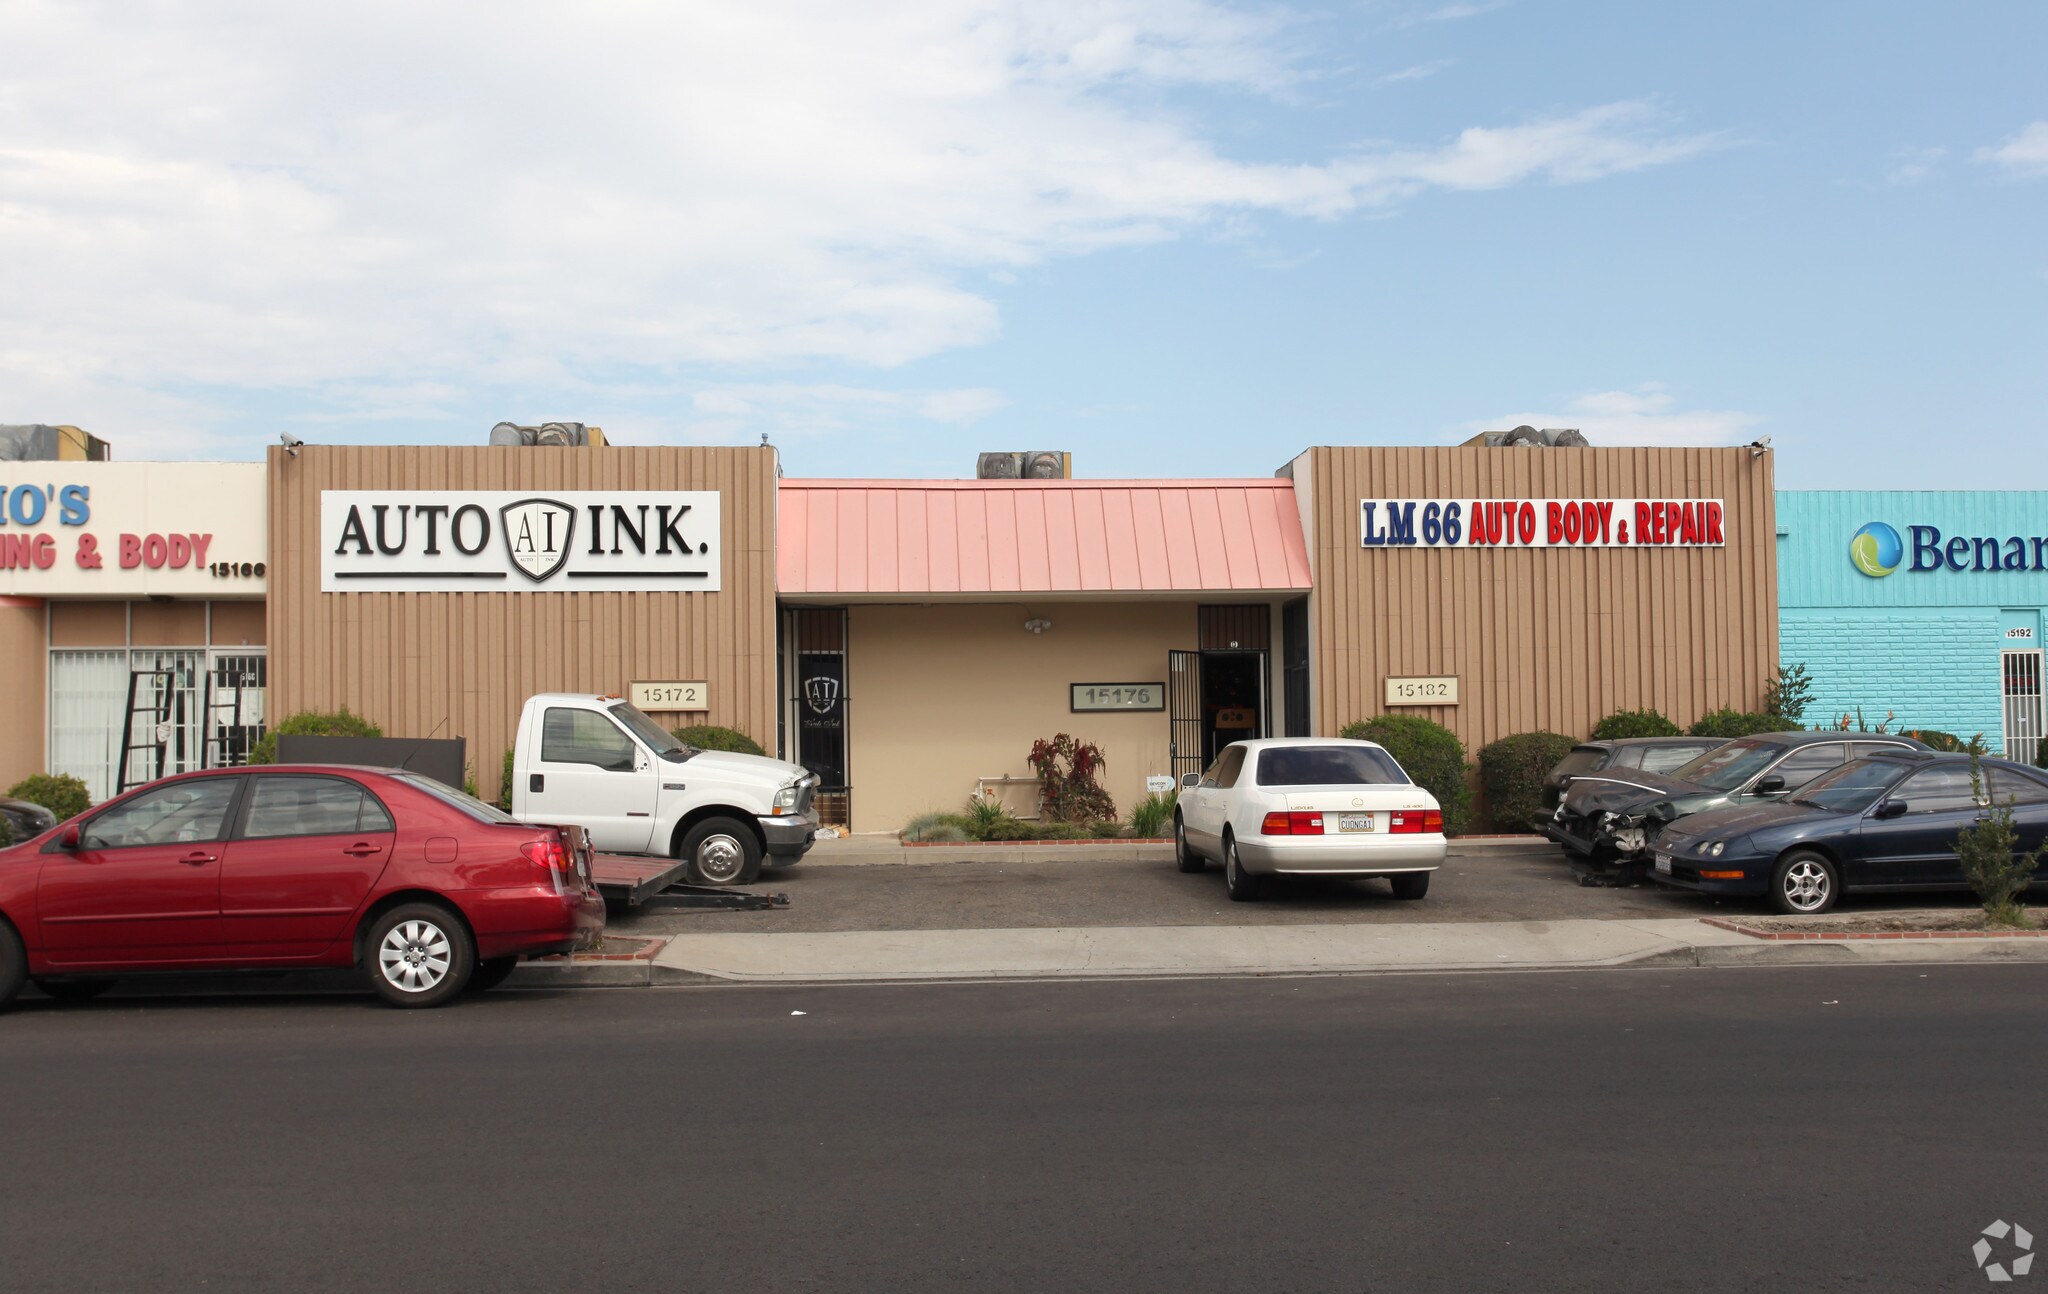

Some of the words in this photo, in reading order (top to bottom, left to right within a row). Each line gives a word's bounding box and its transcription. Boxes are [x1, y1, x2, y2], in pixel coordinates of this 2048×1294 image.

[335, 504, 491, 555] AUTO
[588, 504, 709, 555] INK.
[1363, 501, 1417, 545] LM
[1422, 501, 1462, 545] 66
[1469, 501, 1536, 545] AUTO
[1547, 501, 1614, 545] BODY
[1618, 519, 1629, 544] &
[1636, 501, 1723, 545] REPAIR
[75, 533, 102, 569] &
[119, 533, 213, 570] BODY
[209, 562, 266, 578] 15166
[2007, 628, 2031, 637] 15192
[643, 688, 696, 702] 15172
[1085, 688, 1151, 704] 15176
[1397, 683, 1448, 697] 15182
